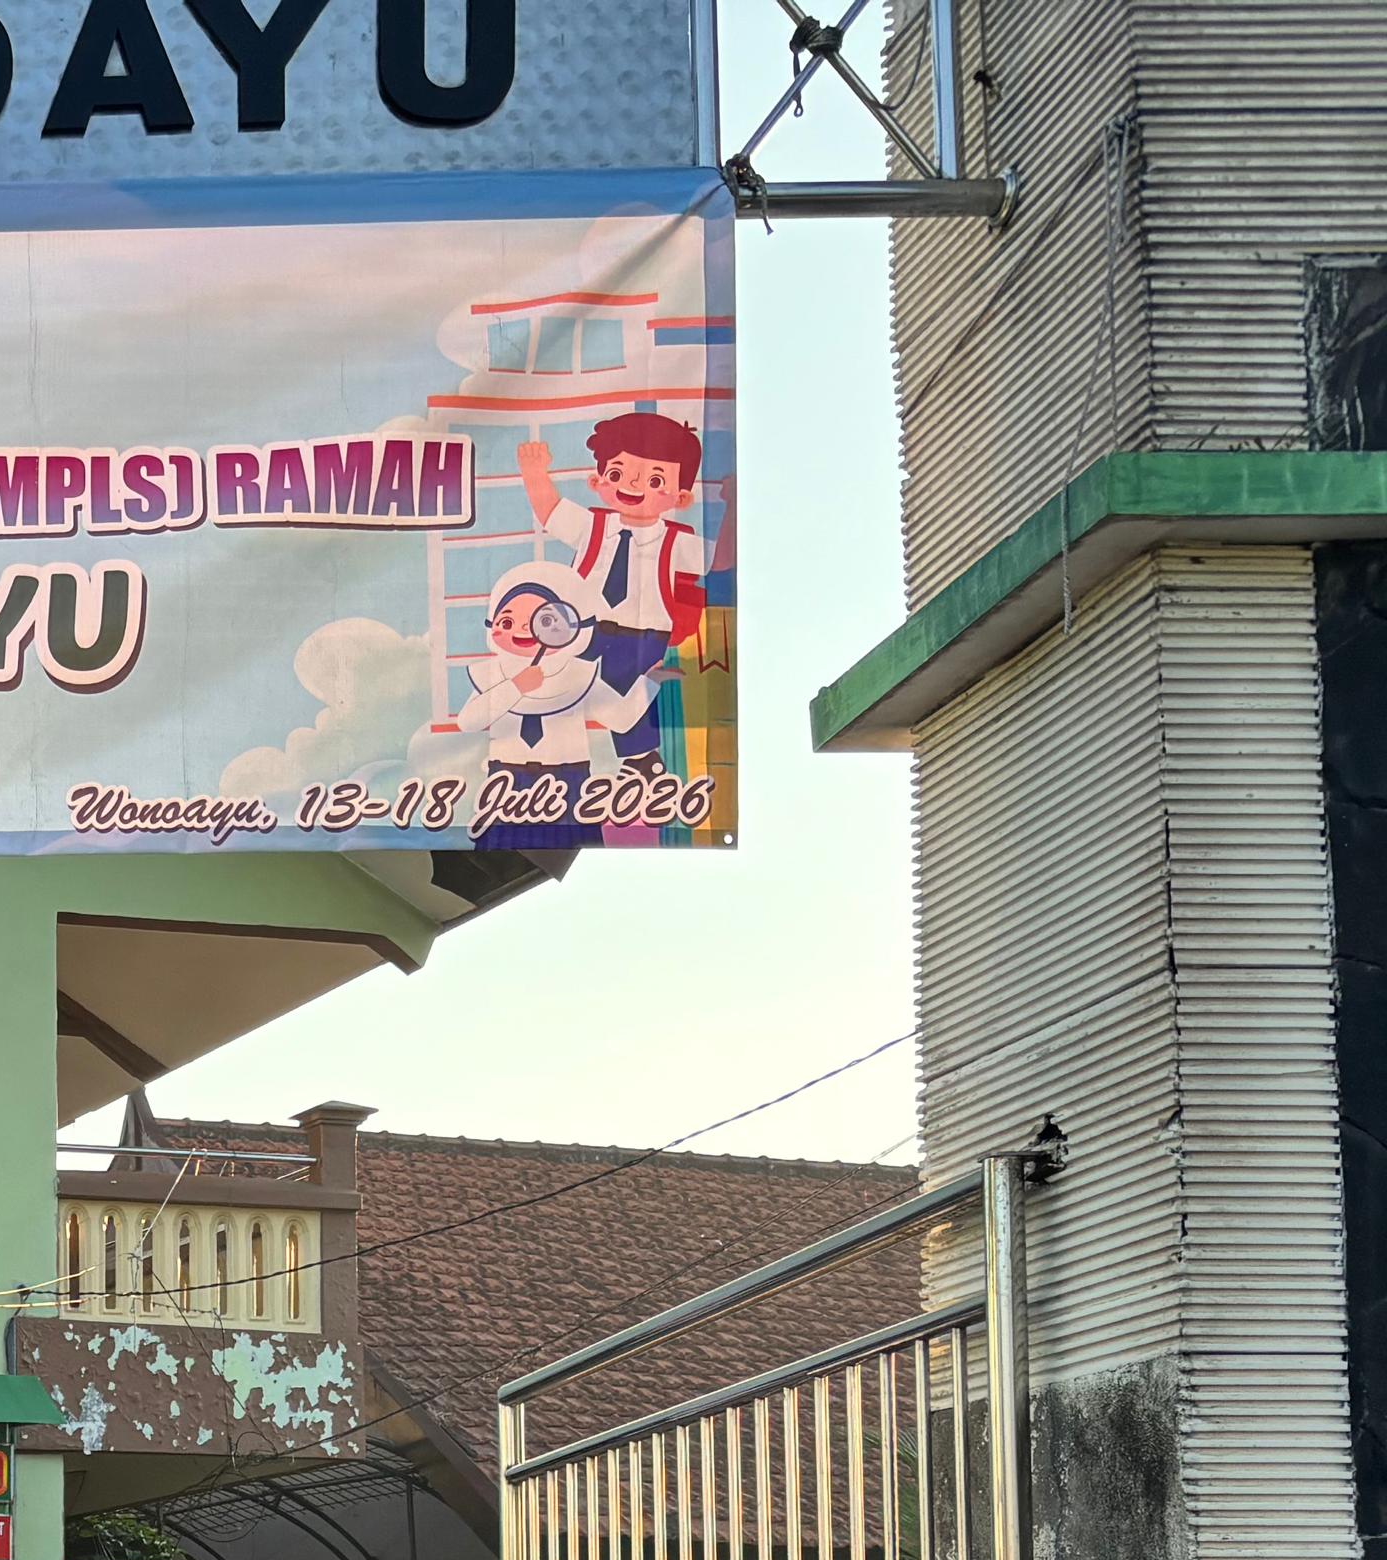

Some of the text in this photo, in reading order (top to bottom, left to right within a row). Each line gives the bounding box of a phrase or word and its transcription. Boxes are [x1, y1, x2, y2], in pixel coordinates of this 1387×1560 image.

[221, 438, 464, 524] RAMAH
[69, 774, 712, 837] Wonoayu, 13-18 Juli 2026
